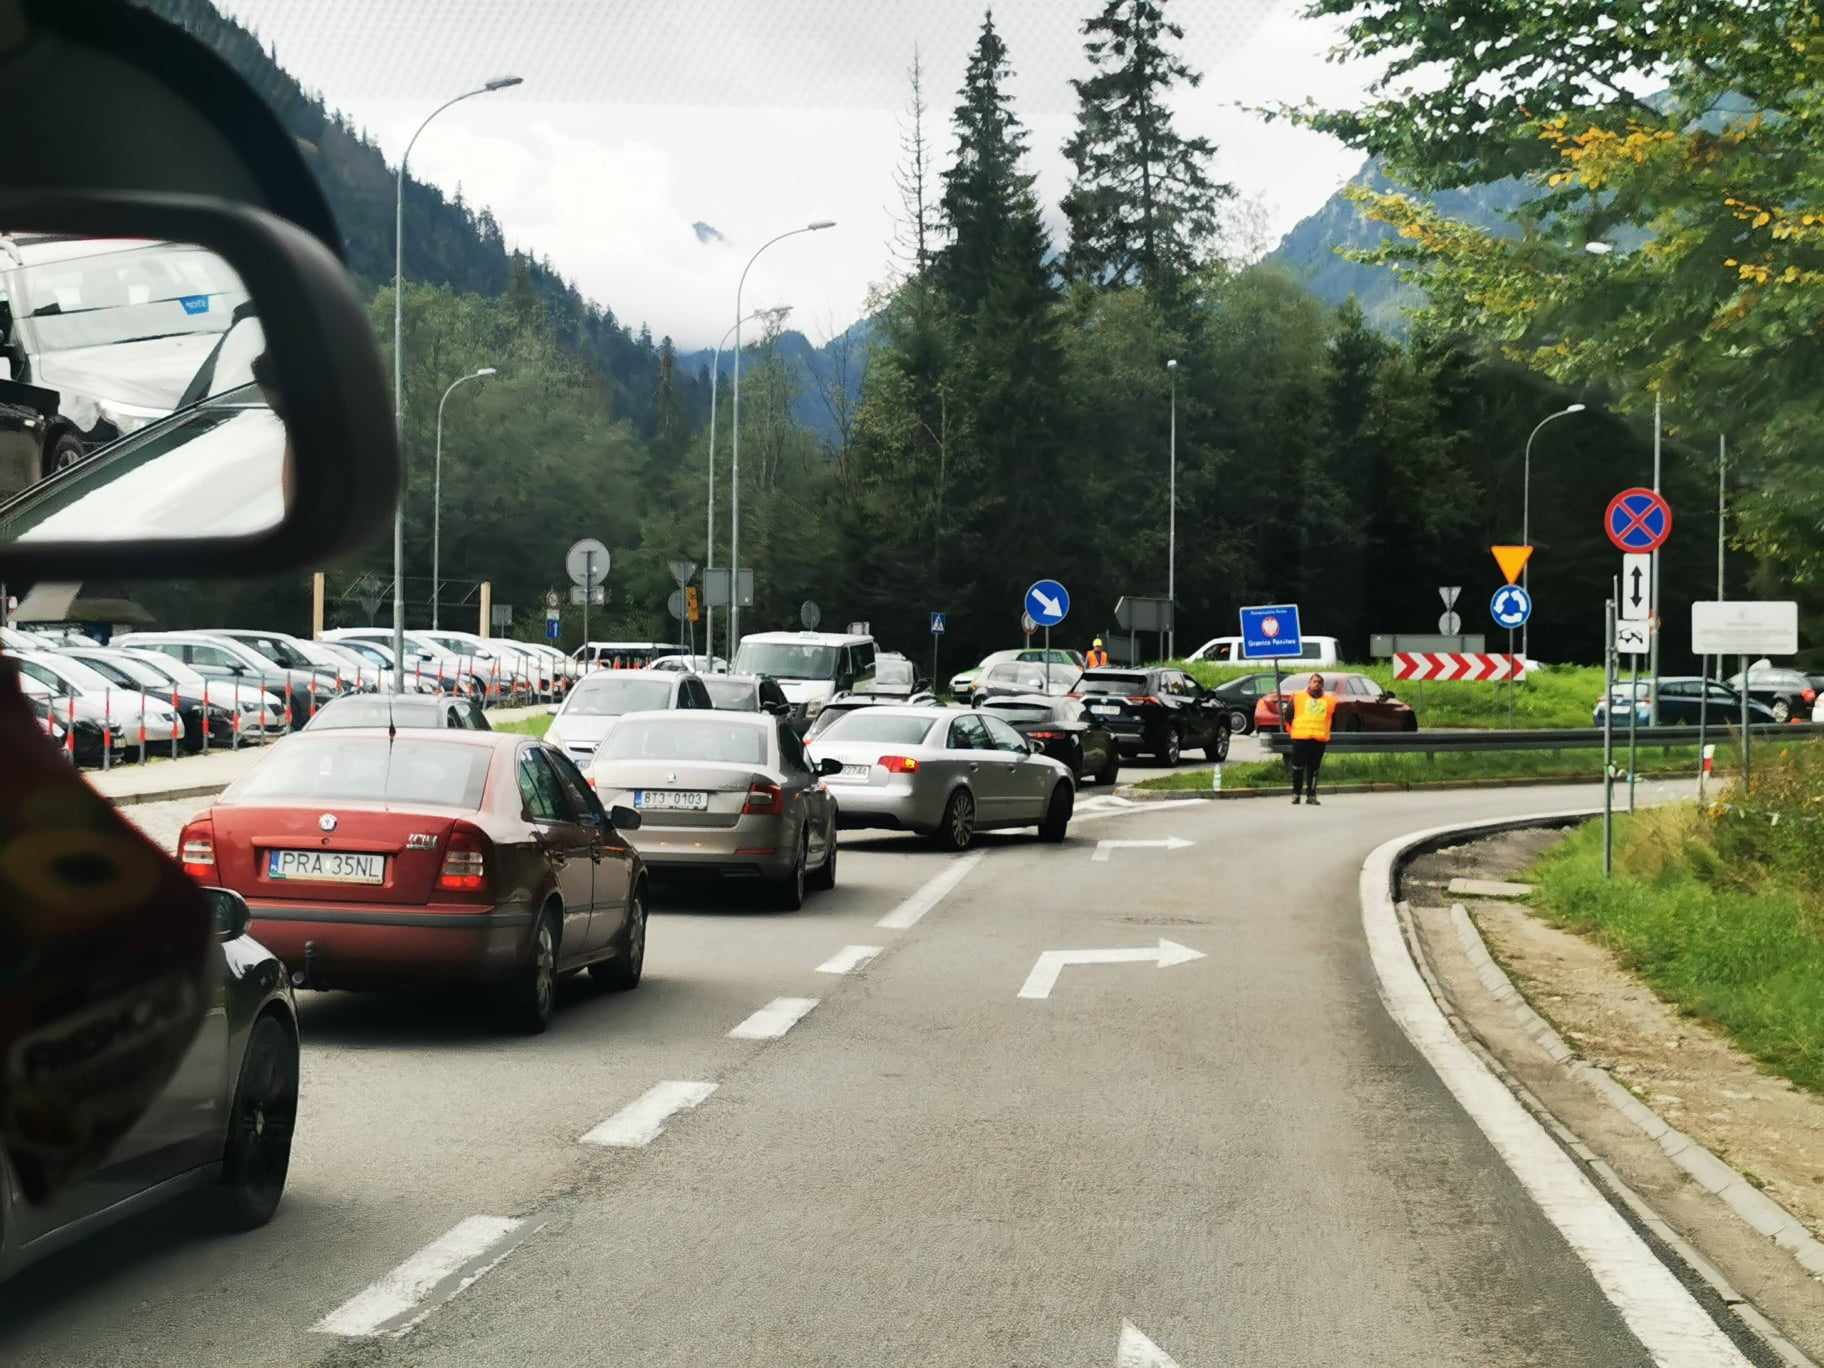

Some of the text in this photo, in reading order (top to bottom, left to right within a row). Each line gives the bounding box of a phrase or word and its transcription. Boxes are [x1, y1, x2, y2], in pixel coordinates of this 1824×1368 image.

[674, 792, 702, 805] 0103
[282, 852, 322, 873] PRA
[331, 855, 379, 878] 35NL
